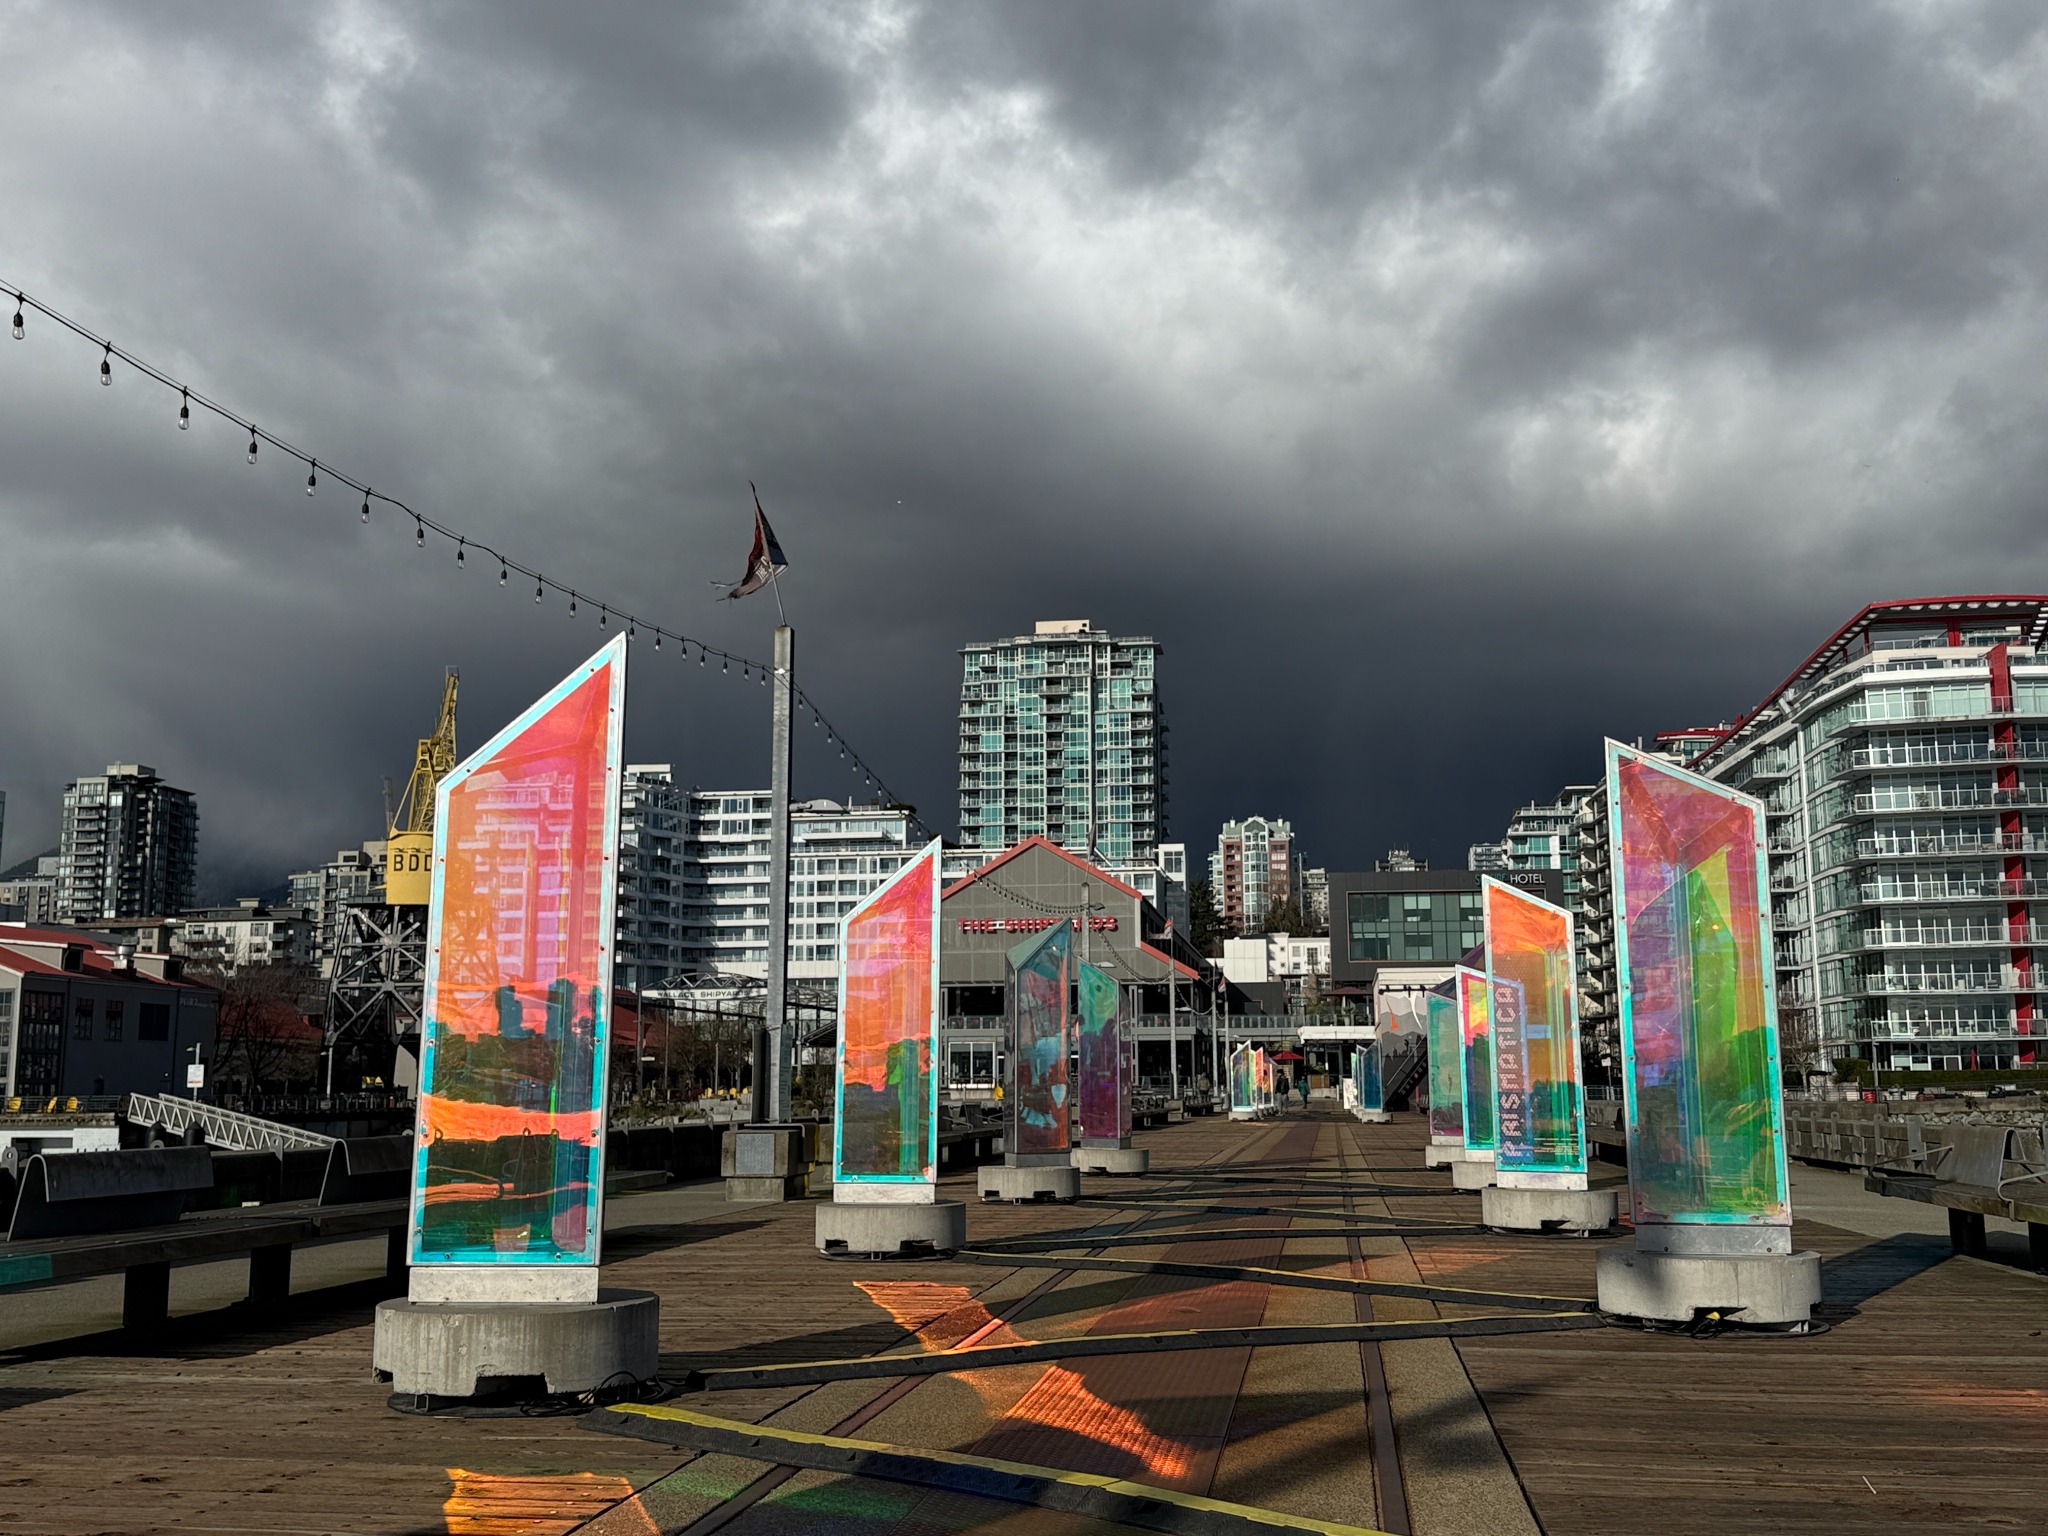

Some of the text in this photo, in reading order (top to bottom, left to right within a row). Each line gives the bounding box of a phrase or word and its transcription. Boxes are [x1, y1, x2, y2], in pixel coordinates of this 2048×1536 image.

[1510, 873, 1546, 884] HOTEL
[957, 916, 1116, 933] THE SHIPYDS
[657, 991, 696, 999] WALLACE
[1494, 987, 1524, 1158] PRISMATICA
